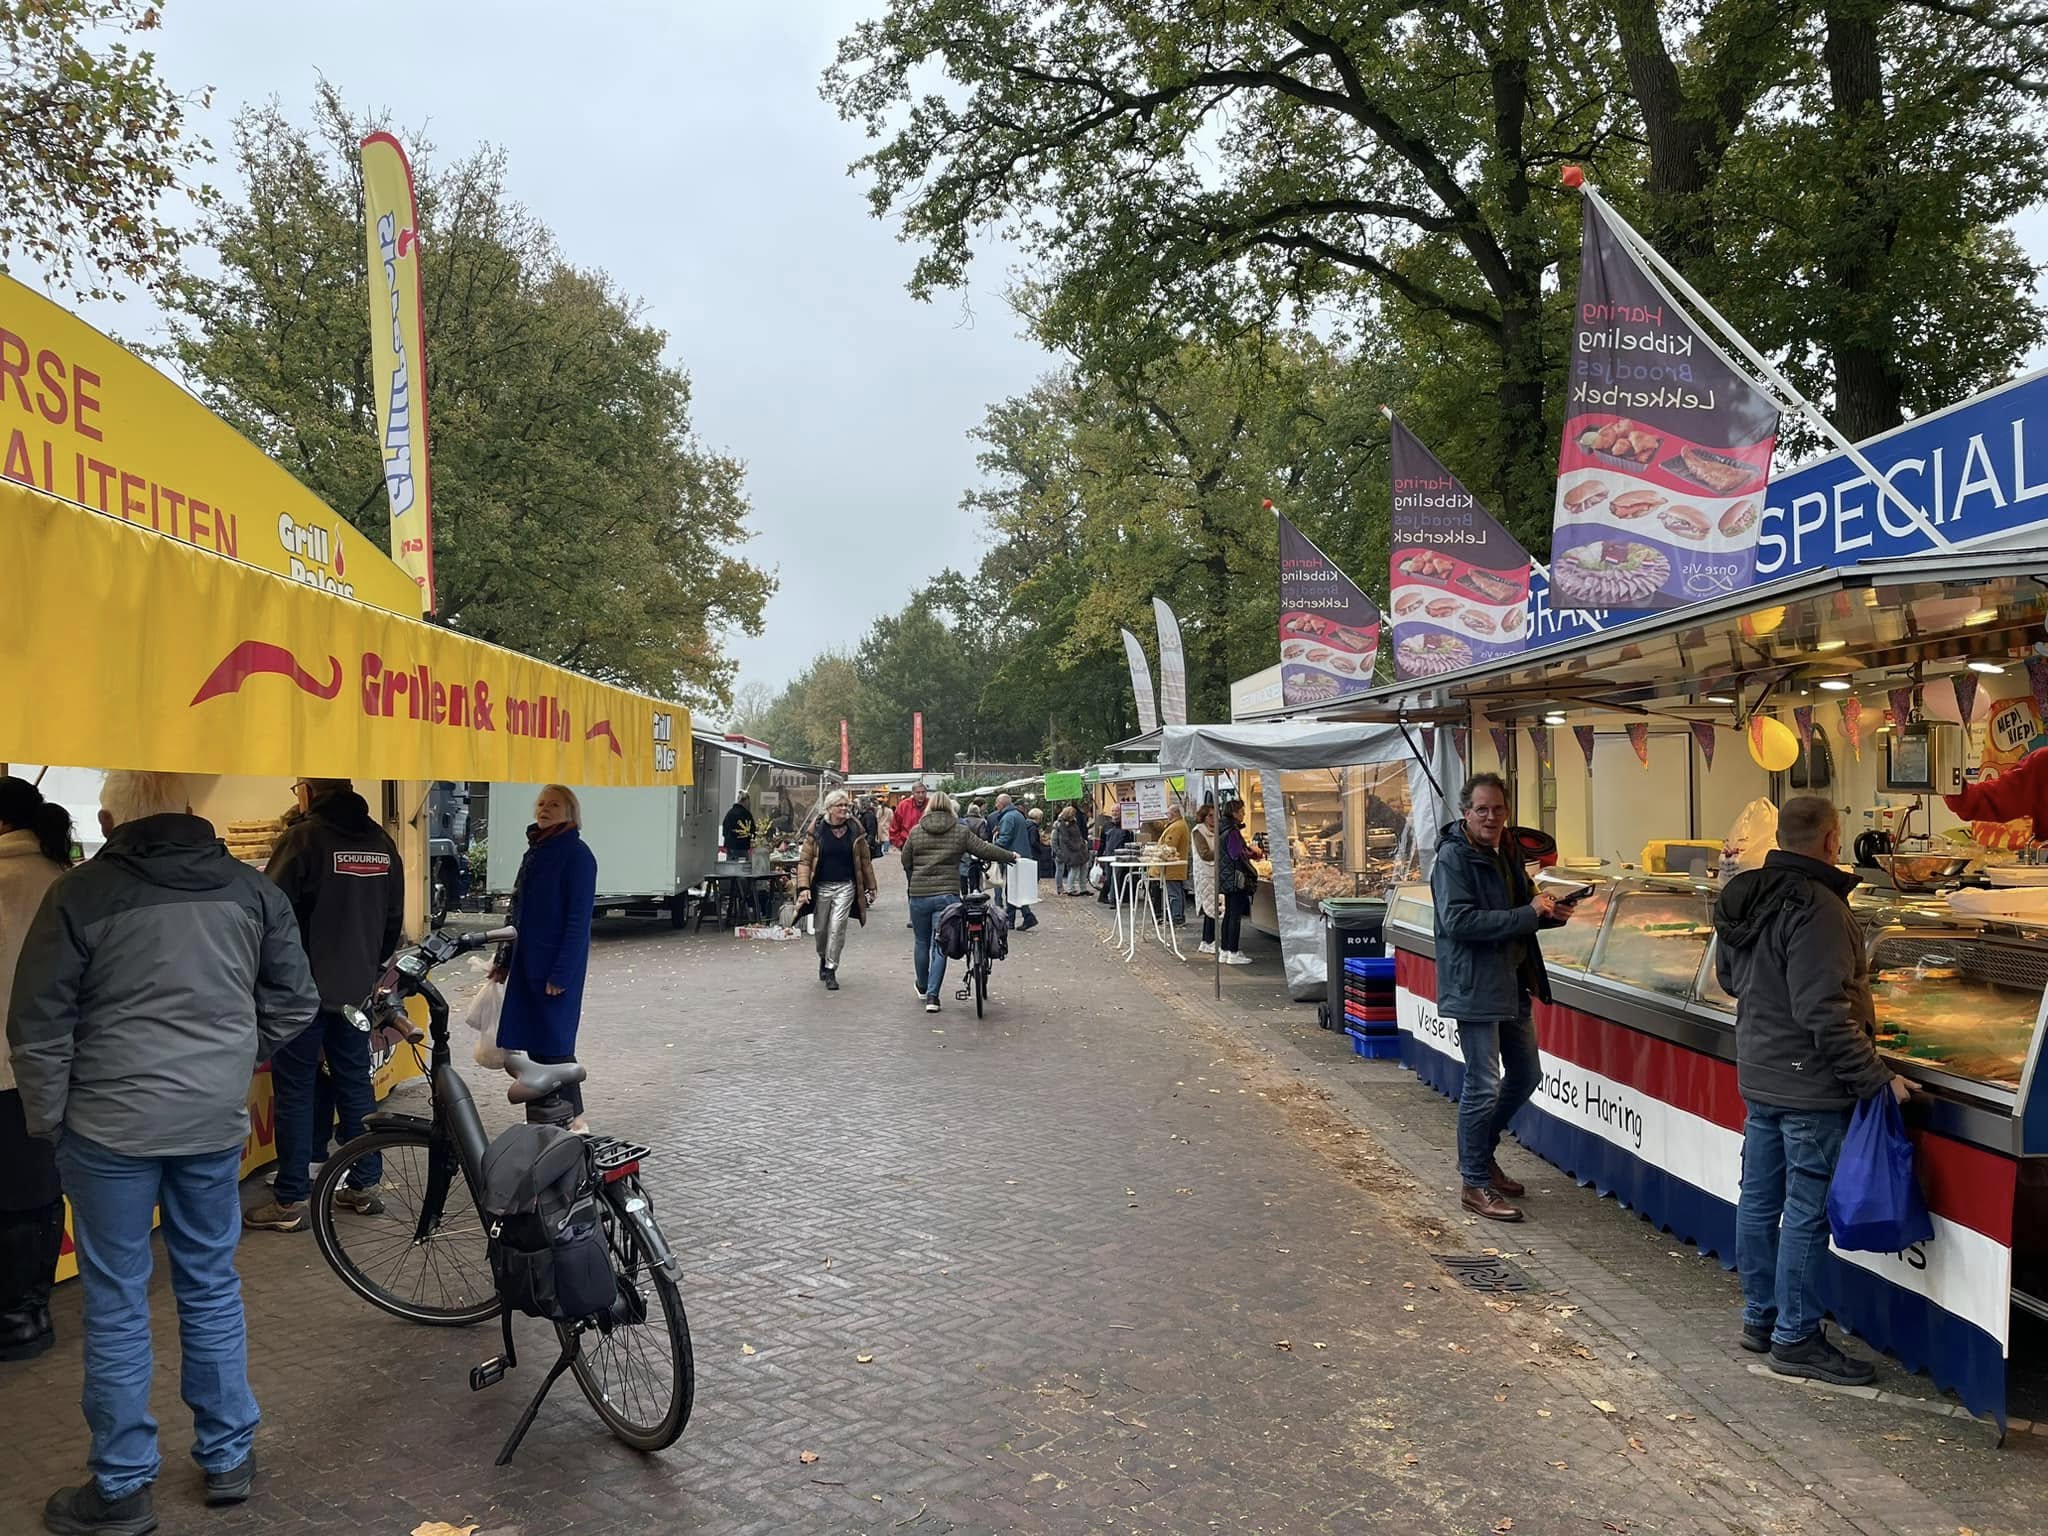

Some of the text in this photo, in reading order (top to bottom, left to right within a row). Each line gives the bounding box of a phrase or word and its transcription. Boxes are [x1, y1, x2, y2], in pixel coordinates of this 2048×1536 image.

[278, 511, 329, 566] Grill
[1997, 707, 2022, 733] HEP!
[1347, 937, 1377, 945] ROVA
[1585, 1080, 1642, 1149] Haring
